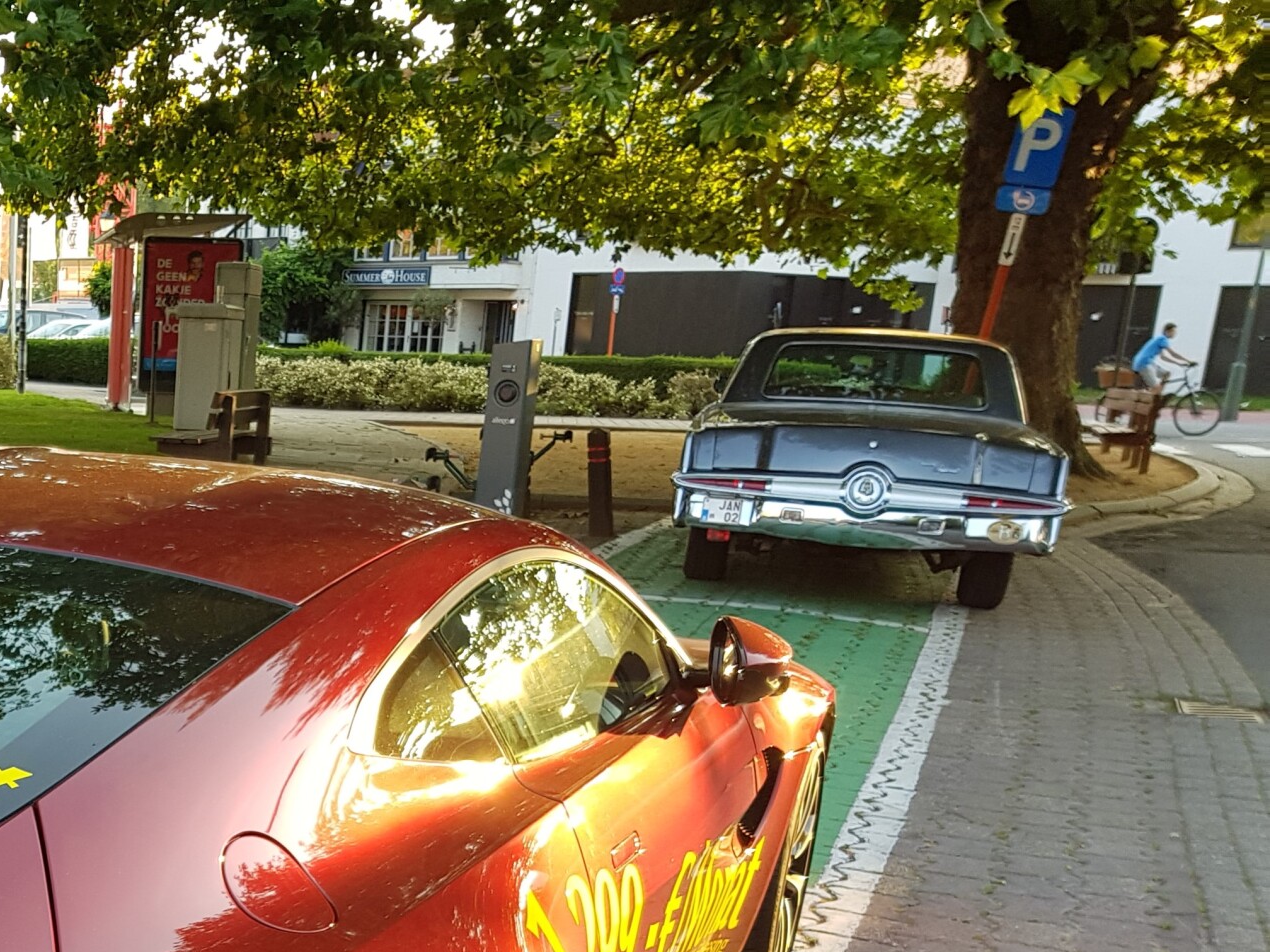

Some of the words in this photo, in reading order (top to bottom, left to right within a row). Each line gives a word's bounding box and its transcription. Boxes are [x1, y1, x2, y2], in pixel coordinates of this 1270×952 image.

[1013, 118, 1062, 172] P
[157, 259, 172, 268] DE
[156, 272, 187, 281] GEEN
[344, 270, 381, 282] SUMMER
[394, 269, 427, 282] HOUSE
[719, 500, 740, 511] JAN
[724, 512, 739, 523] 02
